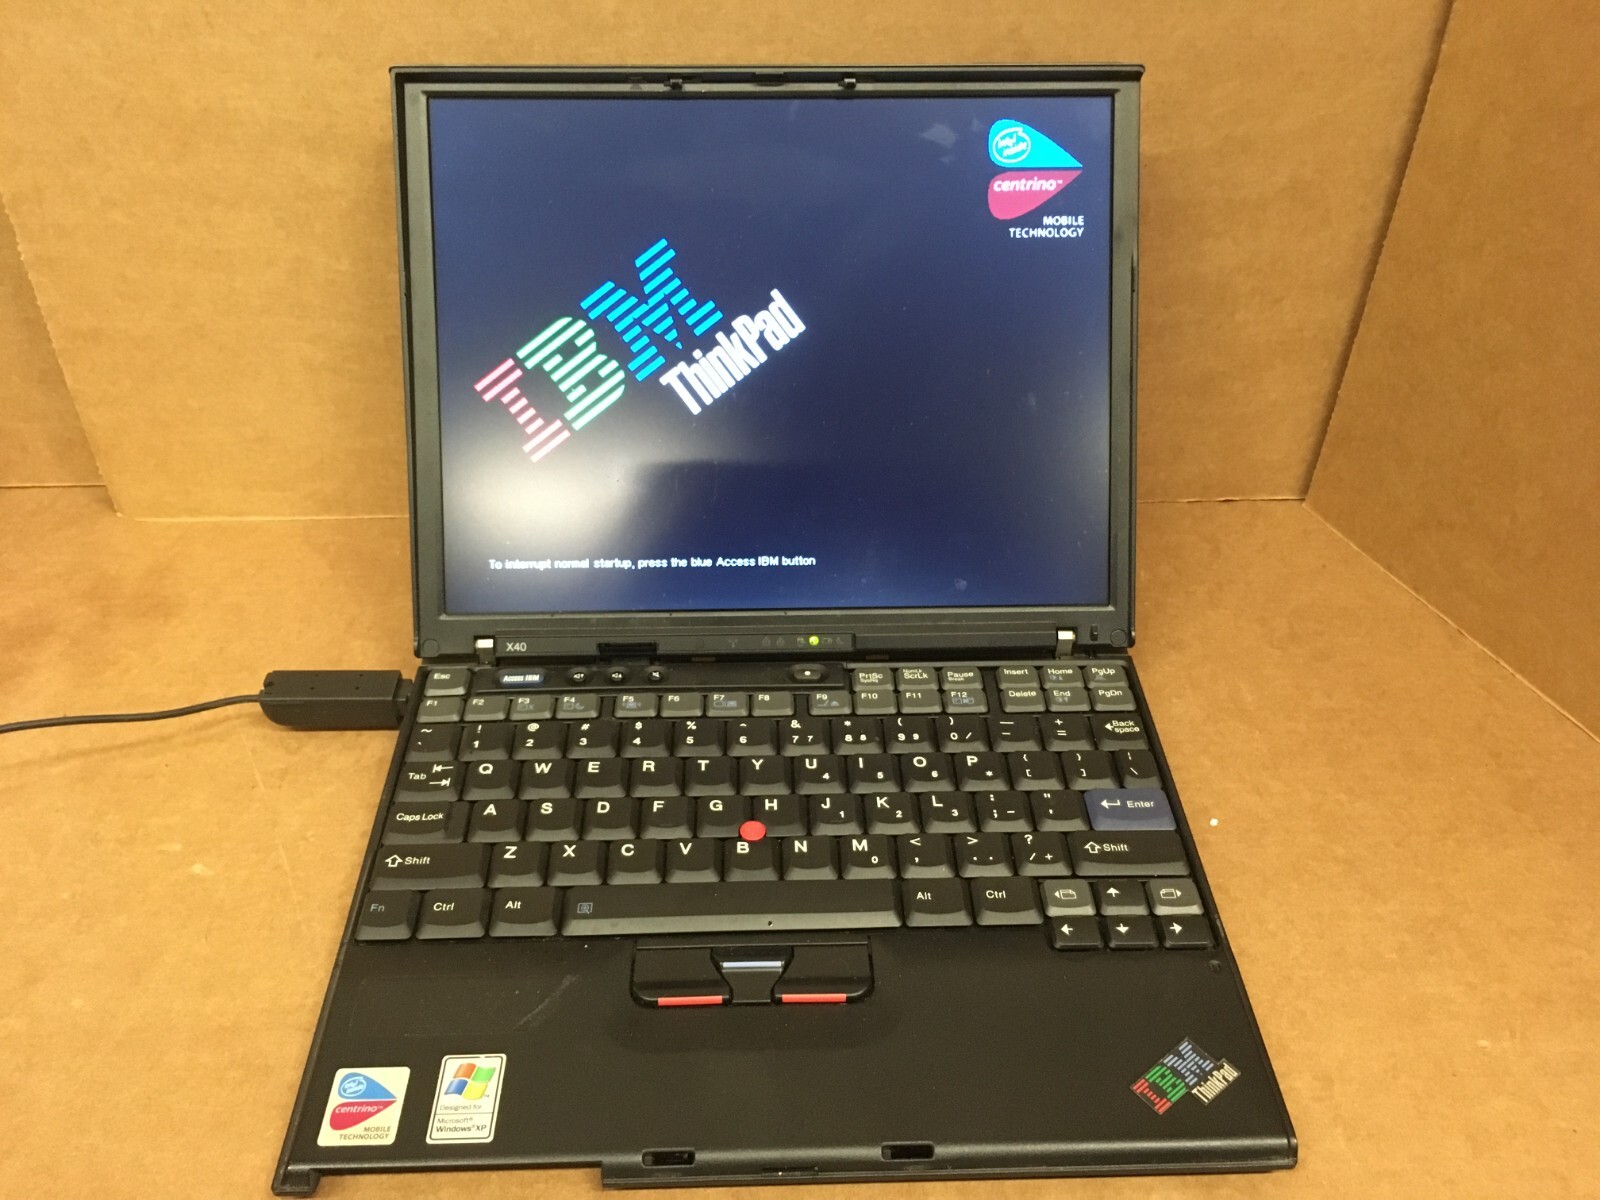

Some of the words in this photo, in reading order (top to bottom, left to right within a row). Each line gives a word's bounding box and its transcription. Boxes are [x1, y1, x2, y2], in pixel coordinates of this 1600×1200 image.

[1042, 216, 1085, 226] MOBILE
[1009, 228, 1085, 238] TECHNOLOGY
[474, 238, 723, 463] IBM
[659, 288, 806, 415] ThinkPad
[488, 559, 503, 569] To
[505, 559, 551, 571] interrupt
[554, 559, 590, 569] normal
[593, 558, 636, 570] startup,
[638, 557, 668, 569] press
[670, 557, 688, 568] the
[691, 557, 713, 567] blue
[716, 556, 756, 567] Access
[758, 556, 779, 566] IBM
[781, 555, 817, 566] button
[507, 643, 526, 651] X40
[904, 672, 928, 680] ScrLk
[947, 671, 974, 679] Pause
[1092, 667, 1116, 676] PgUp
[503, 674, 523, 682] Access
[524, 674, 539, 682] IBM
[1053, 689, 1071, 697] End
[528, 723, 539, 731] @
[635, 722, 642, 730] $
[687, 721, 696, 729] %
[791, 720, 801, 728] &
[1114, 725, 1140, 733] space
[860, 734, 867, 742] 8
[643, 761, 655, 771] R
[698, 760, 709, 771] T
[752, 759, 763, 770] Y
[806, 759, 817, 769] U
[913, 757, 926, 767] O
[967, 756, 978, 766] P
[479, 764, 493, 774] Q
[535, 763, 552, 773] W
[588, 762, 600, 772] E
[877, 772, 884, 780] 5
[653, 801, 664, 812] F
[710, 800, 722, 811] G
[765, 799, 777, 810] H
[821, 798, 830, 808] J
[877, 797, 889, 808] K
[932, 796, 943, 807] L
[484, 804, 496, 815] A
[541, 803, 552, 814] S
[597, 802, 610, 813] D
[396, 812, 420, 823] Caps
[422, 812, 444, 821] Lock
[896, 810, 903, 818] 2
[952, 809, 959, 817] 3
[1025, 835, 1032, 844] ?
[621, 844, 634, 856] C
[680, 843, 692, 854] V
[736, 842, 750, 854] B
[795, 840, 807, 852] N
[852, 839, 868, 851] M
[1102, 843, 1129, 852] Shift
[504, 846, 517, 858] Z
[563, 845, 576, 857] X
[404, 856, 430, 866] Shift
[872, 856, 879, 864] 0
[986, 890, 1005, 898] Ctrl
[434, 903, 454, 911] Ctrl
[1133, 1041, 1214, 1113] IBM
[1191, 1062, 1239, 1103] ThinkPad
